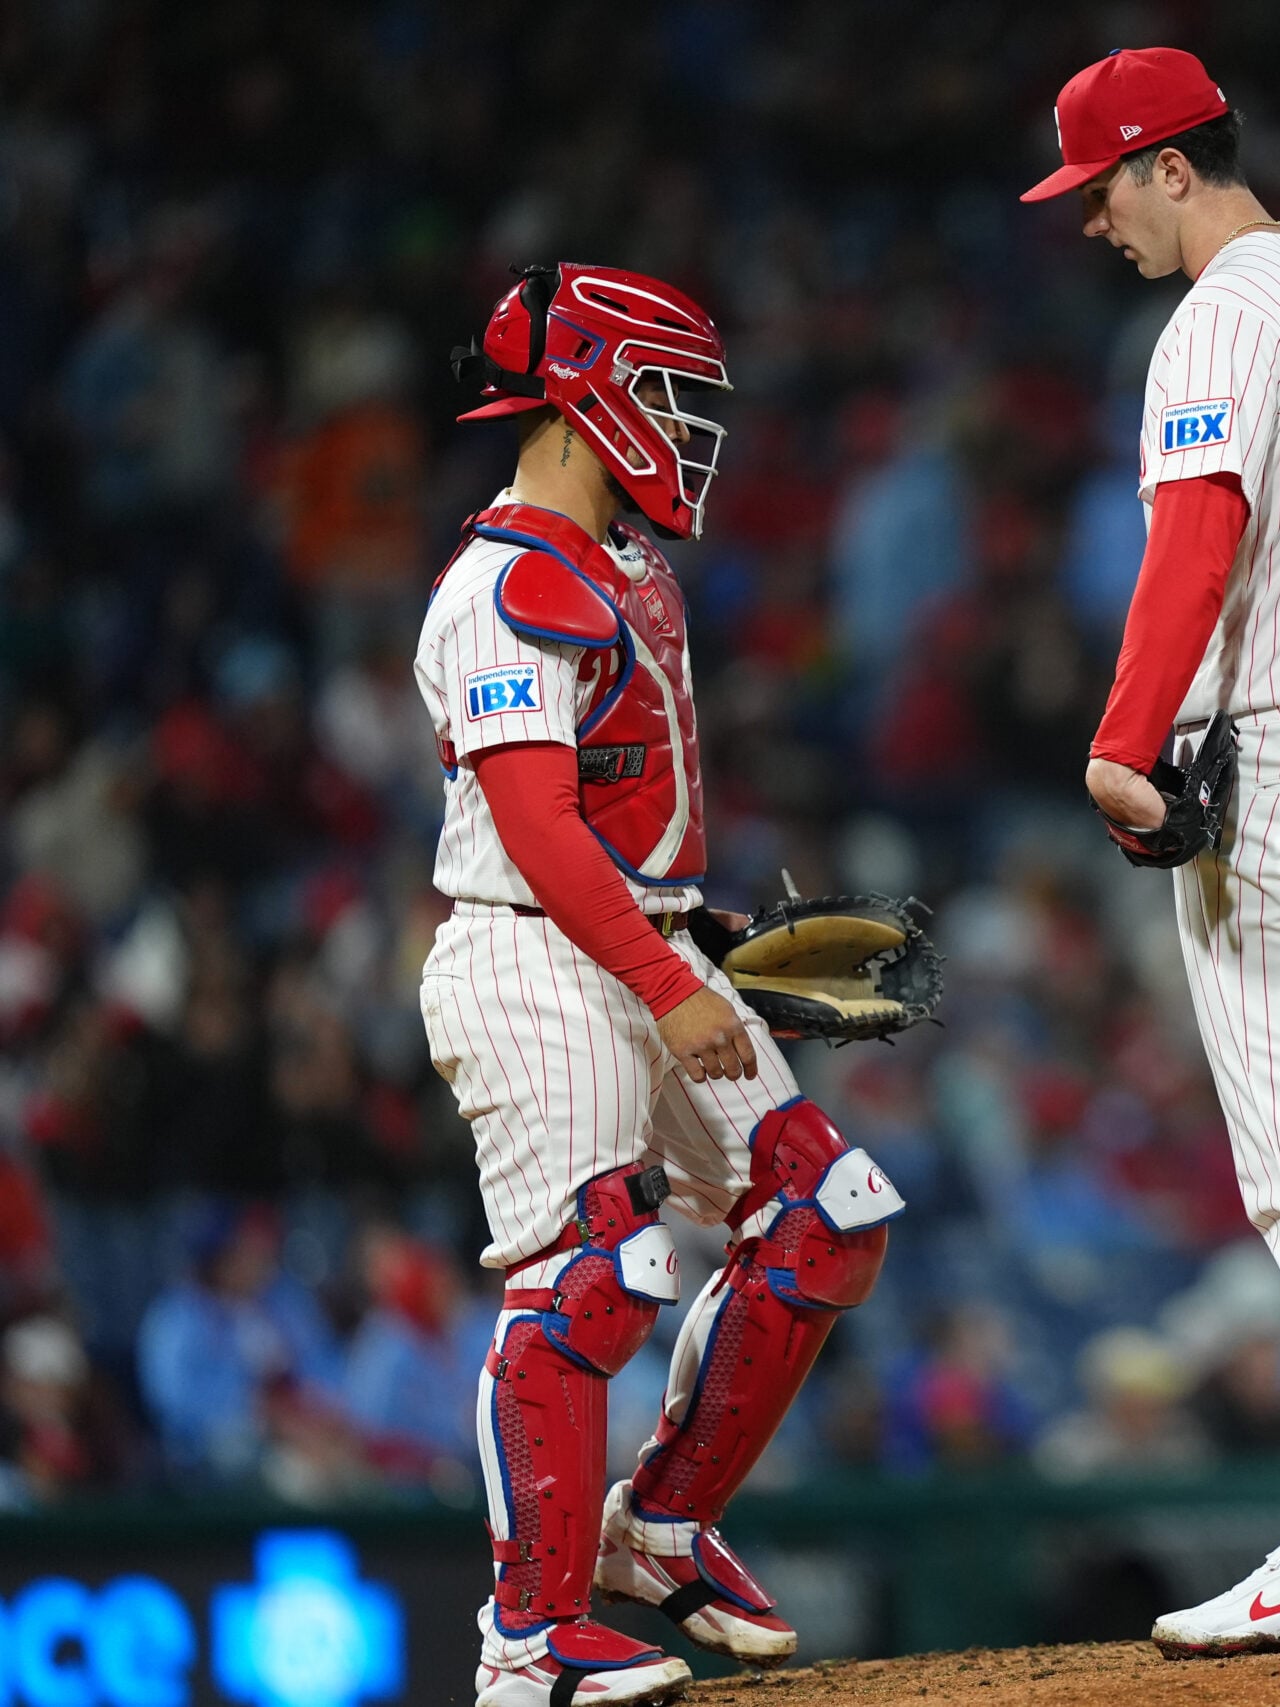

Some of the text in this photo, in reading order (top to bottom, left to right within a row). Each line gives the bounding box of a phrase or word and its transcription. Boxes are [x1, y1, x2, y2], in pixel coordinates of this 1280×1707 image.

[1165, 404, 1218, 418] Independence
[1165, 412, 1227, 450] IBX
[468, 668, 523, 685] Independence
[469, 678, 537, 717] IBX
